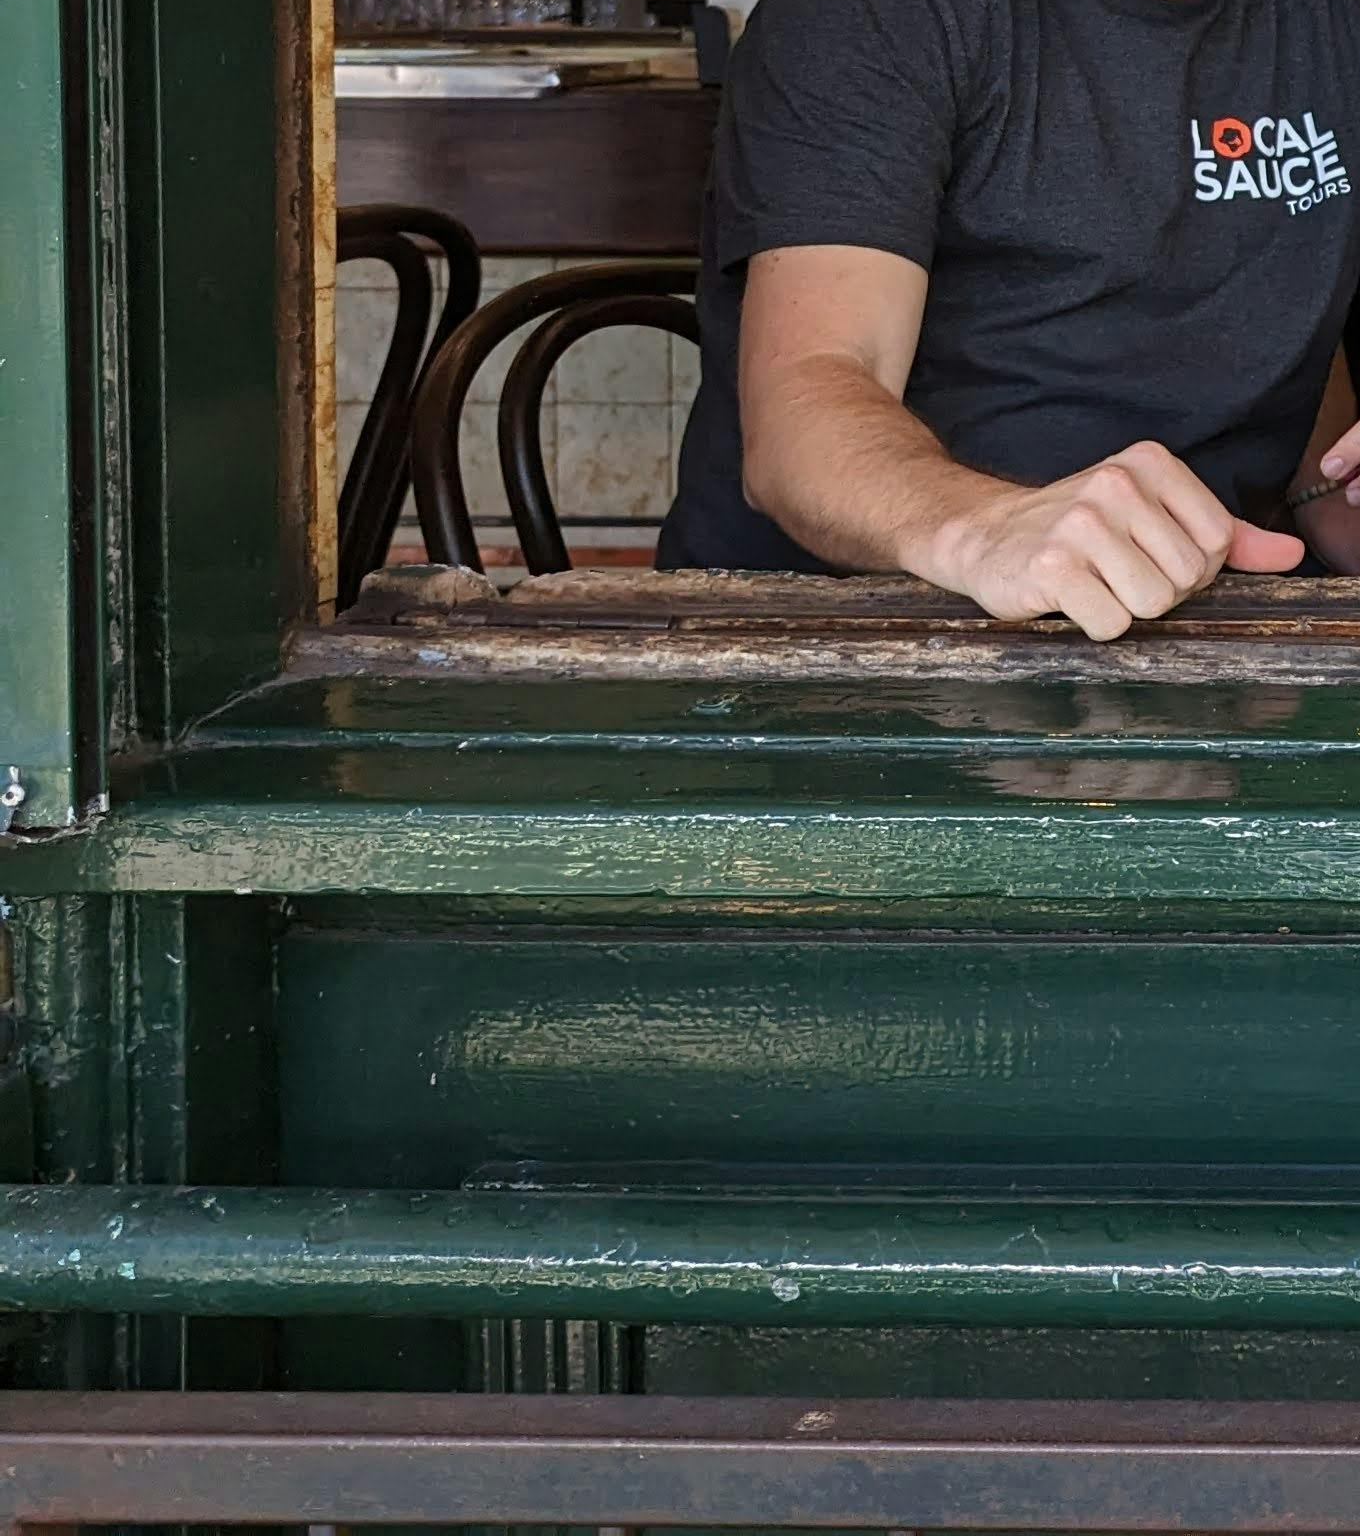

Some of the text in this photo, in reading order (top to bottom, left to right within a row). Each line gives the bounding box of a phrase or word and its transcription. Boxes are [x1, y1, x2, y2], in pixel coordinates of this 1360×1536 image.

[1191, 111, 1335, 159] LOCAL
[1194, 140, 1347, 201] SAUCE
[1285, 178, 1352, 216] TOURS
